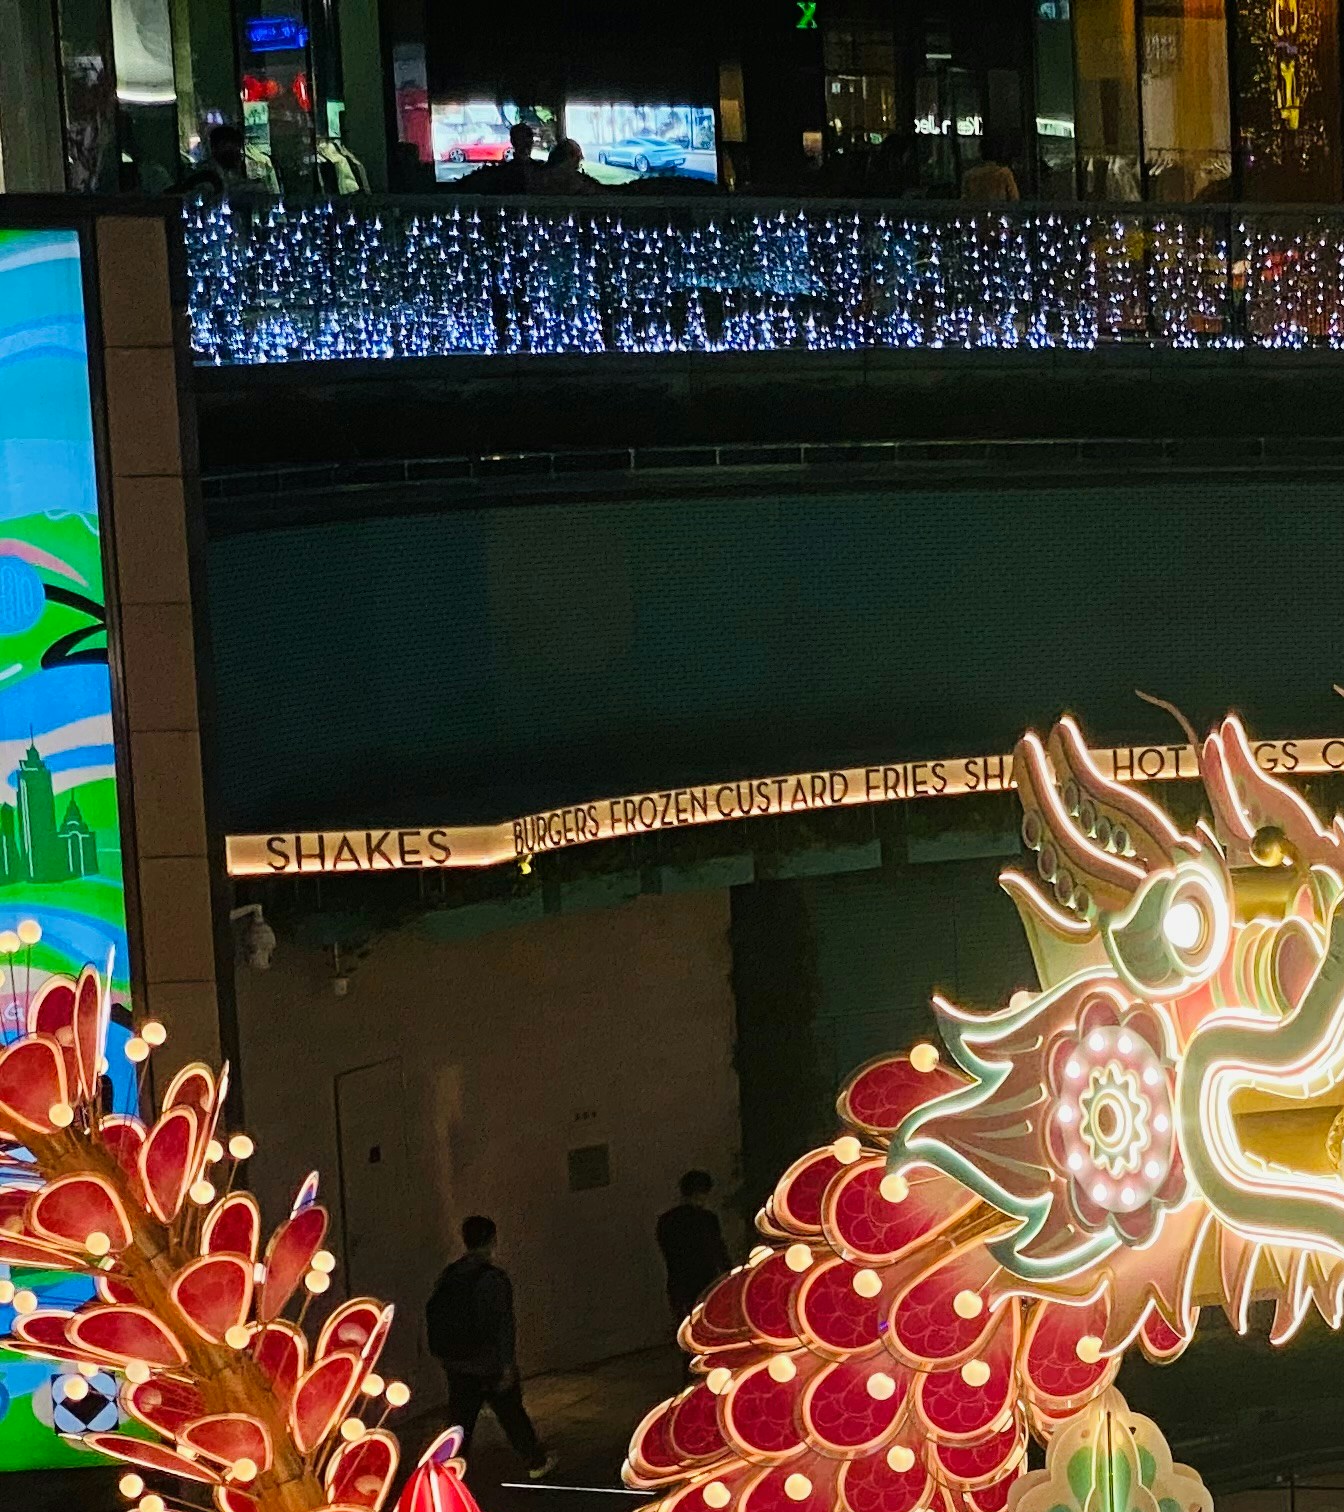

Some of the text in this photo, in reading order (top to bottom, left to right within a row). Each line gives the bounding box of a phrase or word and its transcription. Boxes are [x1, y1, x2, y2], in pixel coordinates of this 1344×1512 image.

[513, 804, 601, 854] BURGERS
[610, 789, 708, 833] FROZEN
[715, 771, 849, 818] CUSTARD
[865, 762, 947, 800] FRIES
[1111, 747, 1188, 780] HOT
[265, 828, 453, 871] SHAKES
